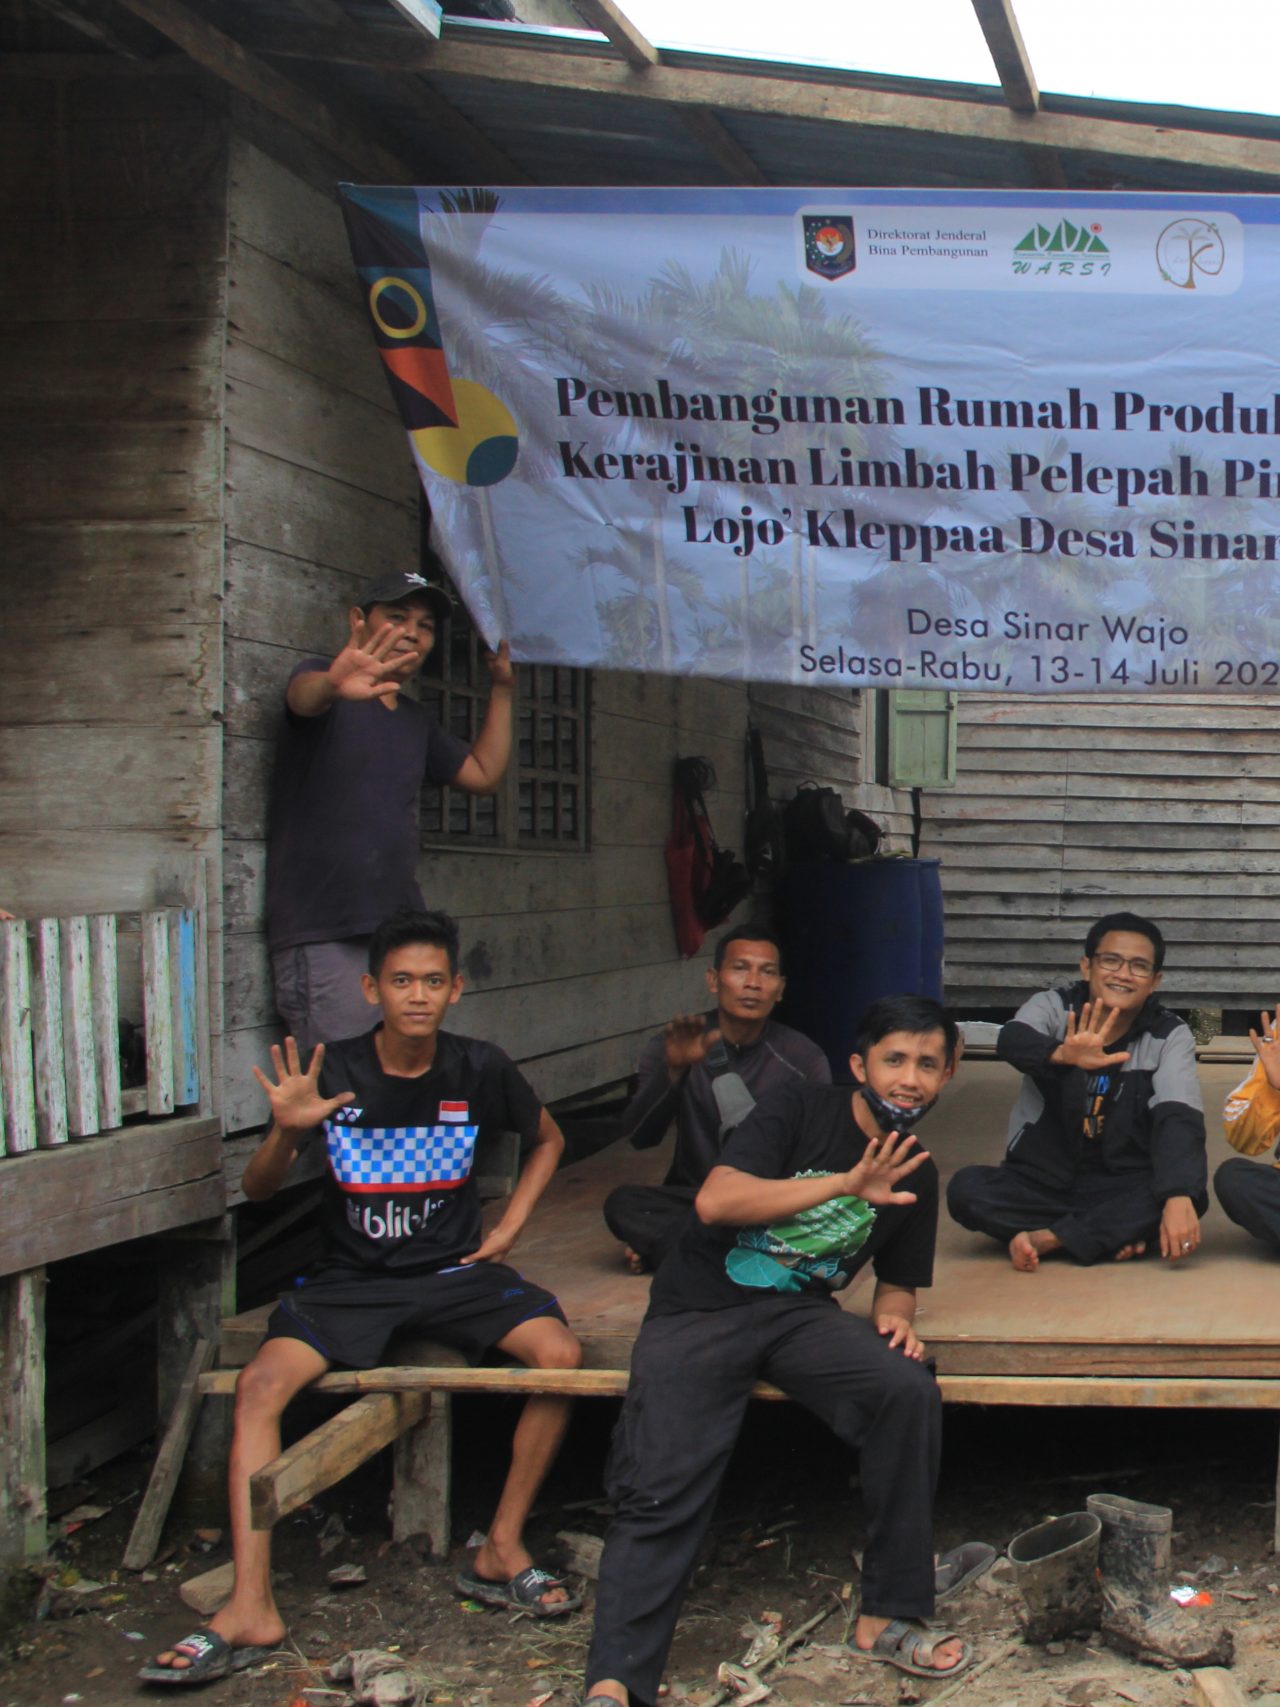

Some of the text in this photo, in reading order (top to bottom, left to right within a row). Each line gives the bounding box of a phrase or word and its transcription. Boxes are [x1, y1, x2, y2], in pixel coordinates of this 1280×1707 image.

[868, 228, 987, 241] Direktorat Jenderal
[868, 244, 989, 260] Bina Pembangunan
[1012, 260, 1111, 277] WARSI
[555, 377, 904, 435] Pembangunan
[919, 386, 1098, 430] Rumah
[557, 441, 797, 494] Kerajinan
[808, 447, 995, 490] Limbah
[1010, 452, 1209, 507] Pelepah
[806, 508, 1005, 563] Kleppaa
[1018, 514, 1139, 560] Desa
[906, 608, 1190, 653] Desa Sinar Wajo
[799, 645, 1013, 687] Selasa-Rabu,
[1031, 656, 1130, 685] 13-14
[1143, 658, 1199, 686] Juli
